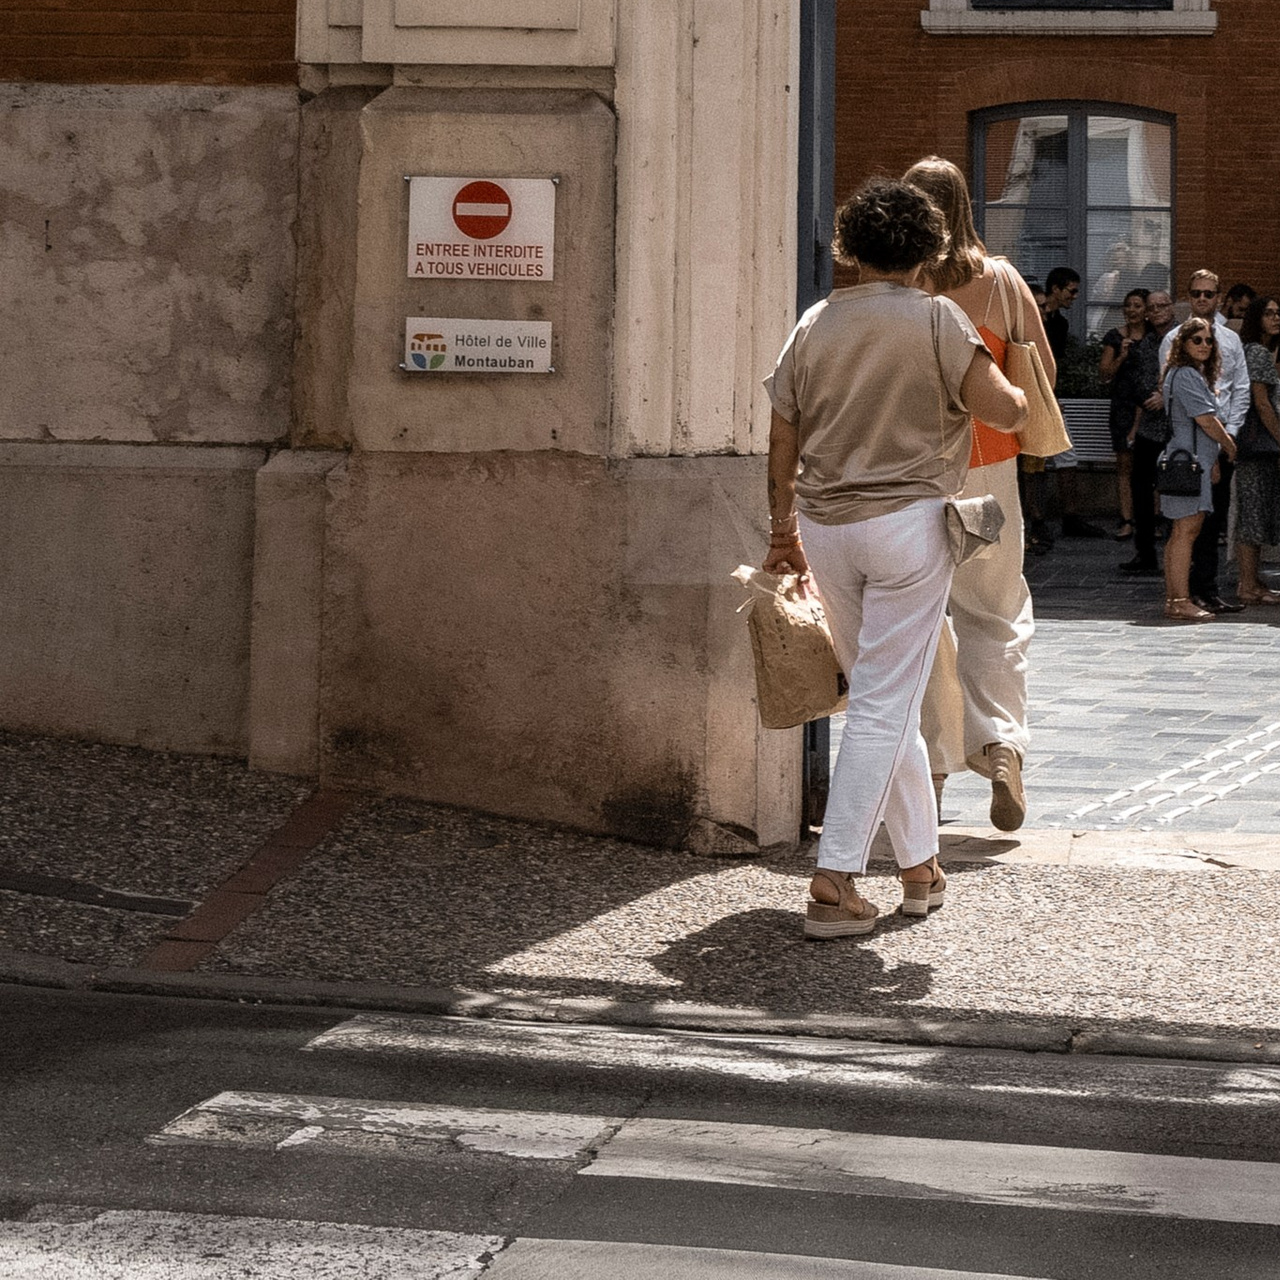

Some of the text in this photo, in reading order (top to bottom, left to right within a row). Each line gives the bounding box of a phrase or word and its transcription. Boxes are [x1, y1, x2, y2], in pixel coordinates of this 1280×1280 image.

[416, 243, 544, 259] ENTREE INTERDITE
[414, 261, 544, 277] A TOUS VEHICULES
[455, 334, 547, 349] Hôtel de Ville
[454, 355, 535, 369] Montauban
